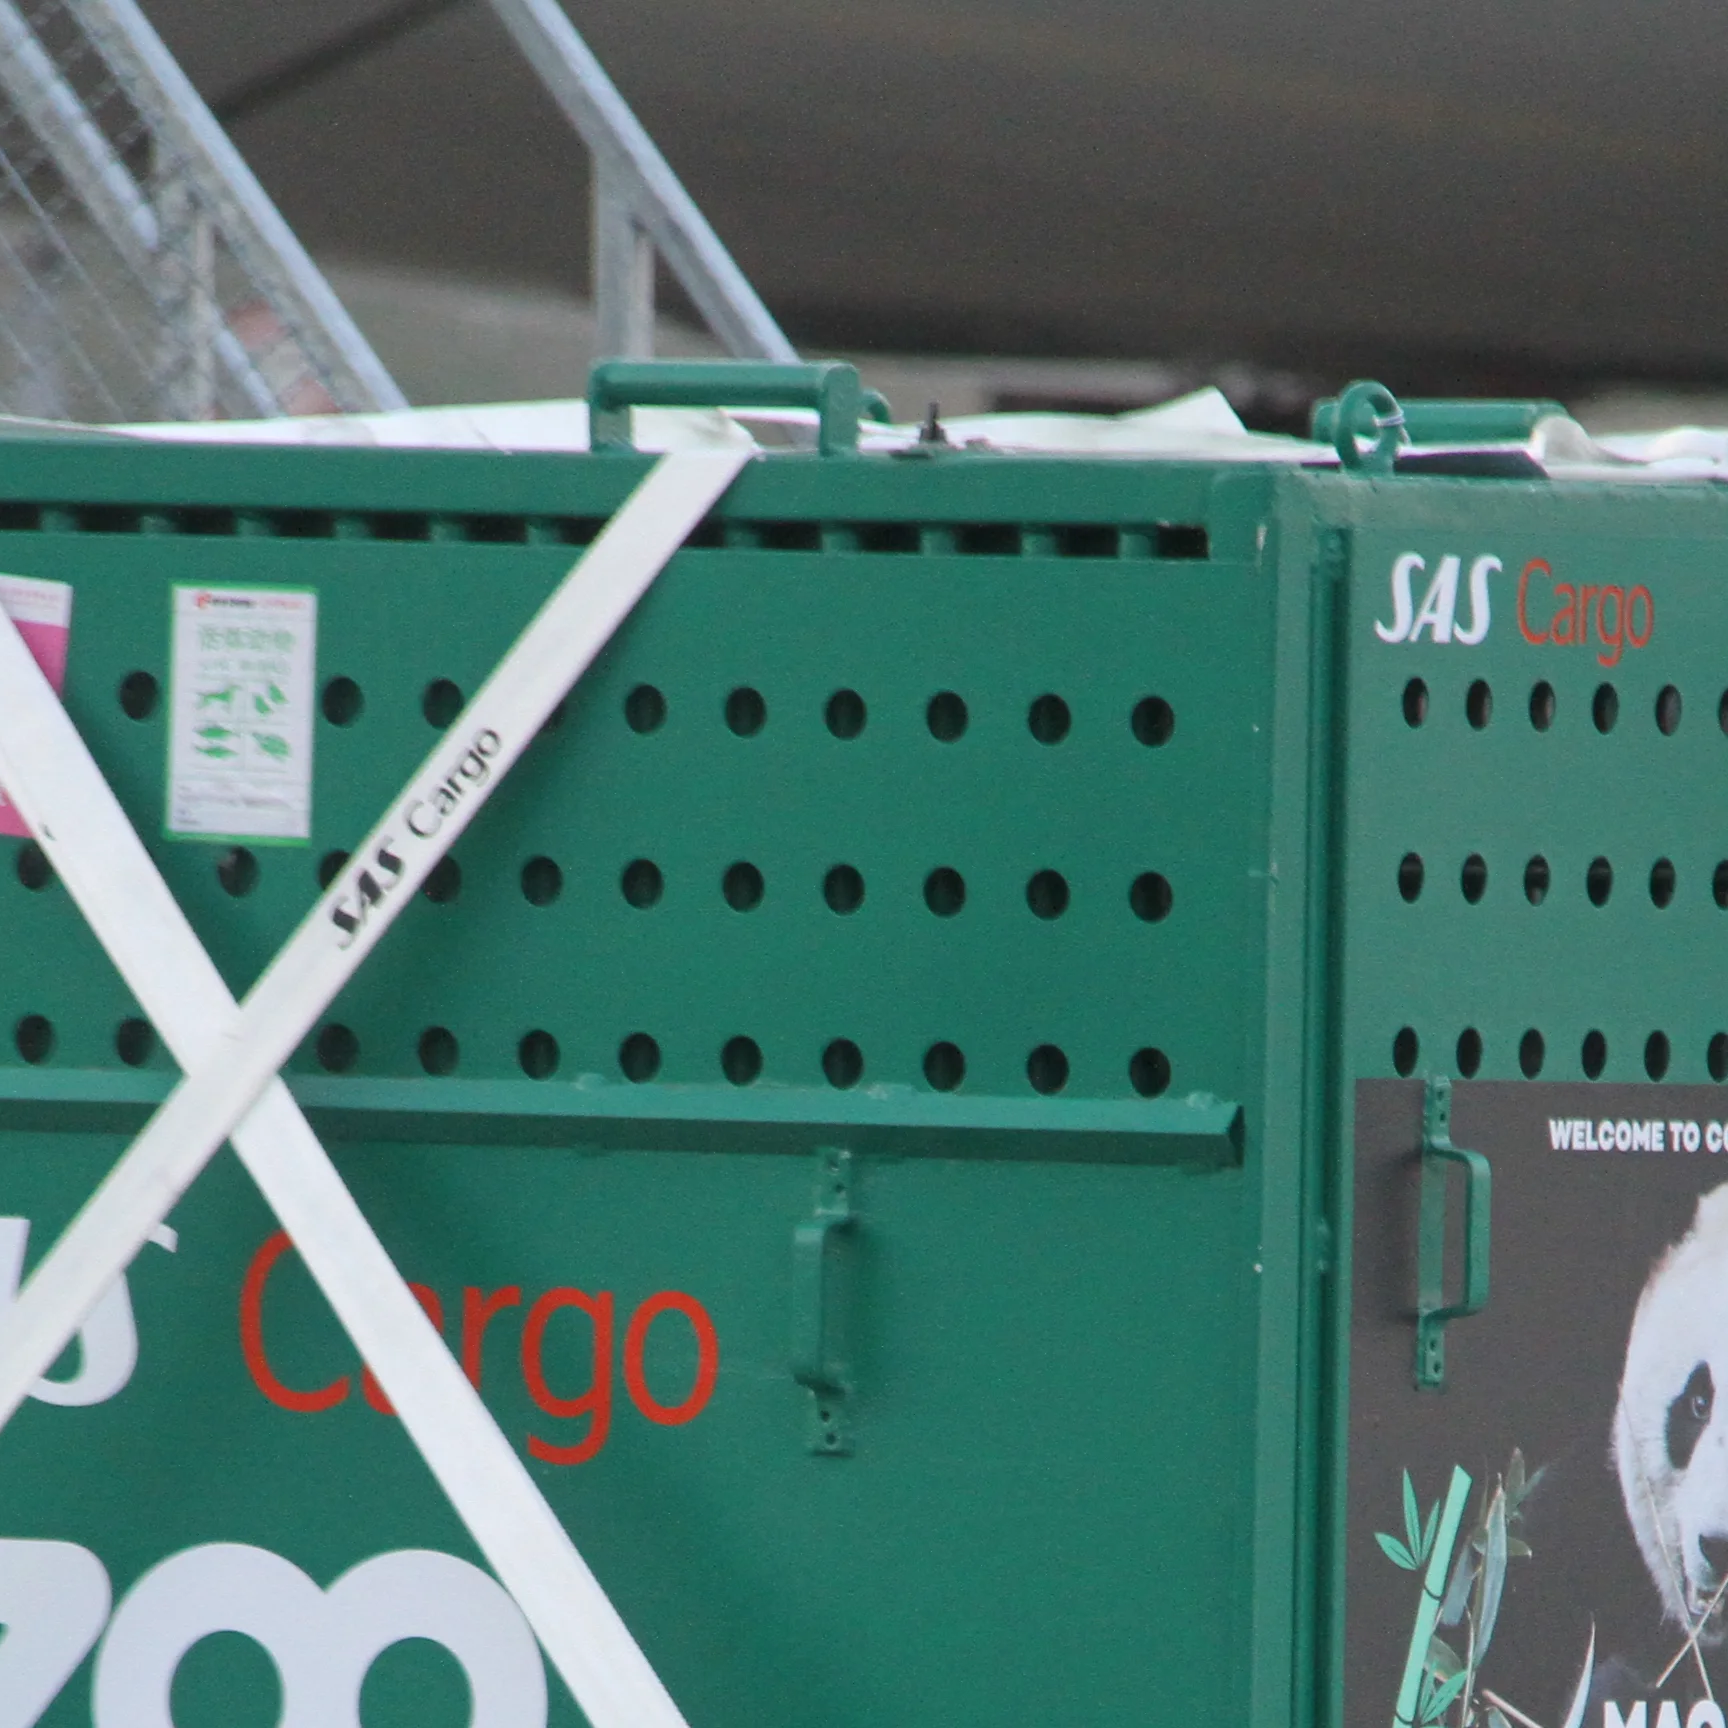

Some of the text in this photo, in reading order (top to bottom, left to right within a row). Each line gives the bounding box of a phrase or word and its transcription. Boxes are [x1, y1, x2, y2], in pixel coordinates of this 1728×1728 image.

[1376, 552, 1655, 668] SAS Cargo
[327, 726, 504, 951] SAS Cargo
[1548, 1118, 1665, 1153] WELCOME
[1669, 1120, 1701, 1154] TO
